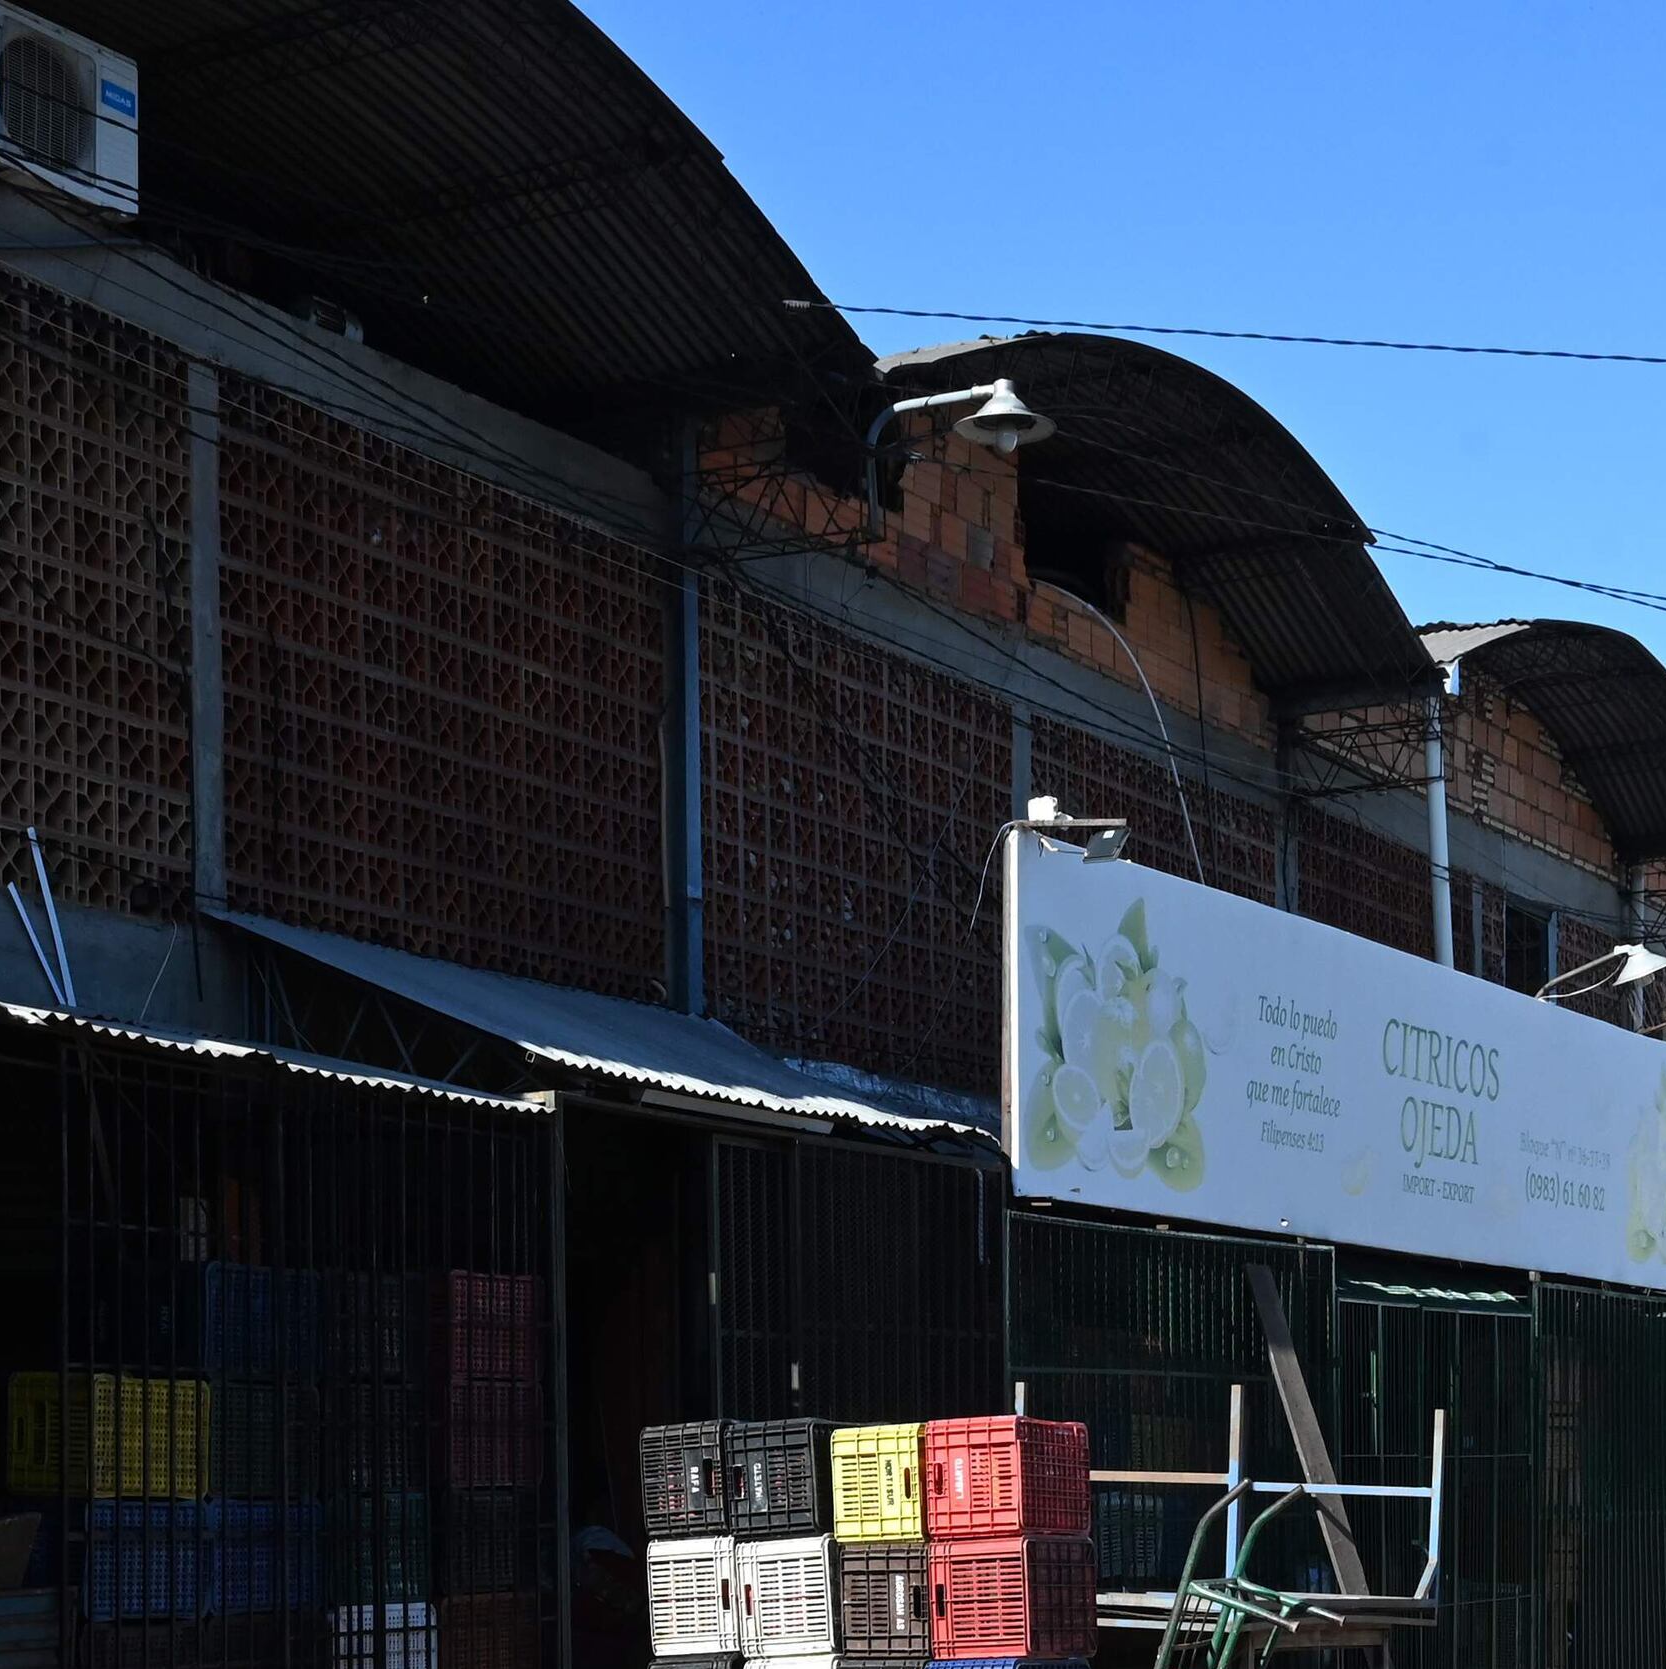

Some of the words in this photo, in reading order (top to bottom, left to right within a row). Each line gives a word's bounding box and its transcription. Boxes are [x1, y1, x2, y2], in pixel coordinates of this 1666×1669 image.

[1258, 995, 1287, 1027] Todo
[1290, 1000, 1300, 1030] lo
[1303, 1010, 1337, 1040] puedo
[1271, 1044, 1285, 1066] en
[1288, 1044, 1322, 1076] Cristo
[1383, 1018, 1500, 1102] CITRICOS
[1246, 1079, 1269, 1108] que
[1272, 1085, 1290, 1106] me
[1290, 1080, 1341, 1118] fortalece
[1260, 1120, 1306, 1151] Filipenses
[1307, 1131, 1324, 1153] 4:13
[1400, 1096, 1479, 1169] OJEDA
[1403, 1174, 1435, 1197] IMPORT
[1442, 1182, 1475, 1204] EXPORT
[1525, 1166, 1560, 1208] (0983)
[1563, 1180, 1575, 1206] 61
[1579, 1184, 1591, 1209] 60
[1593, 1187, 1605, 1211] 82
[690, 1466, 700, 1494] RAFA
